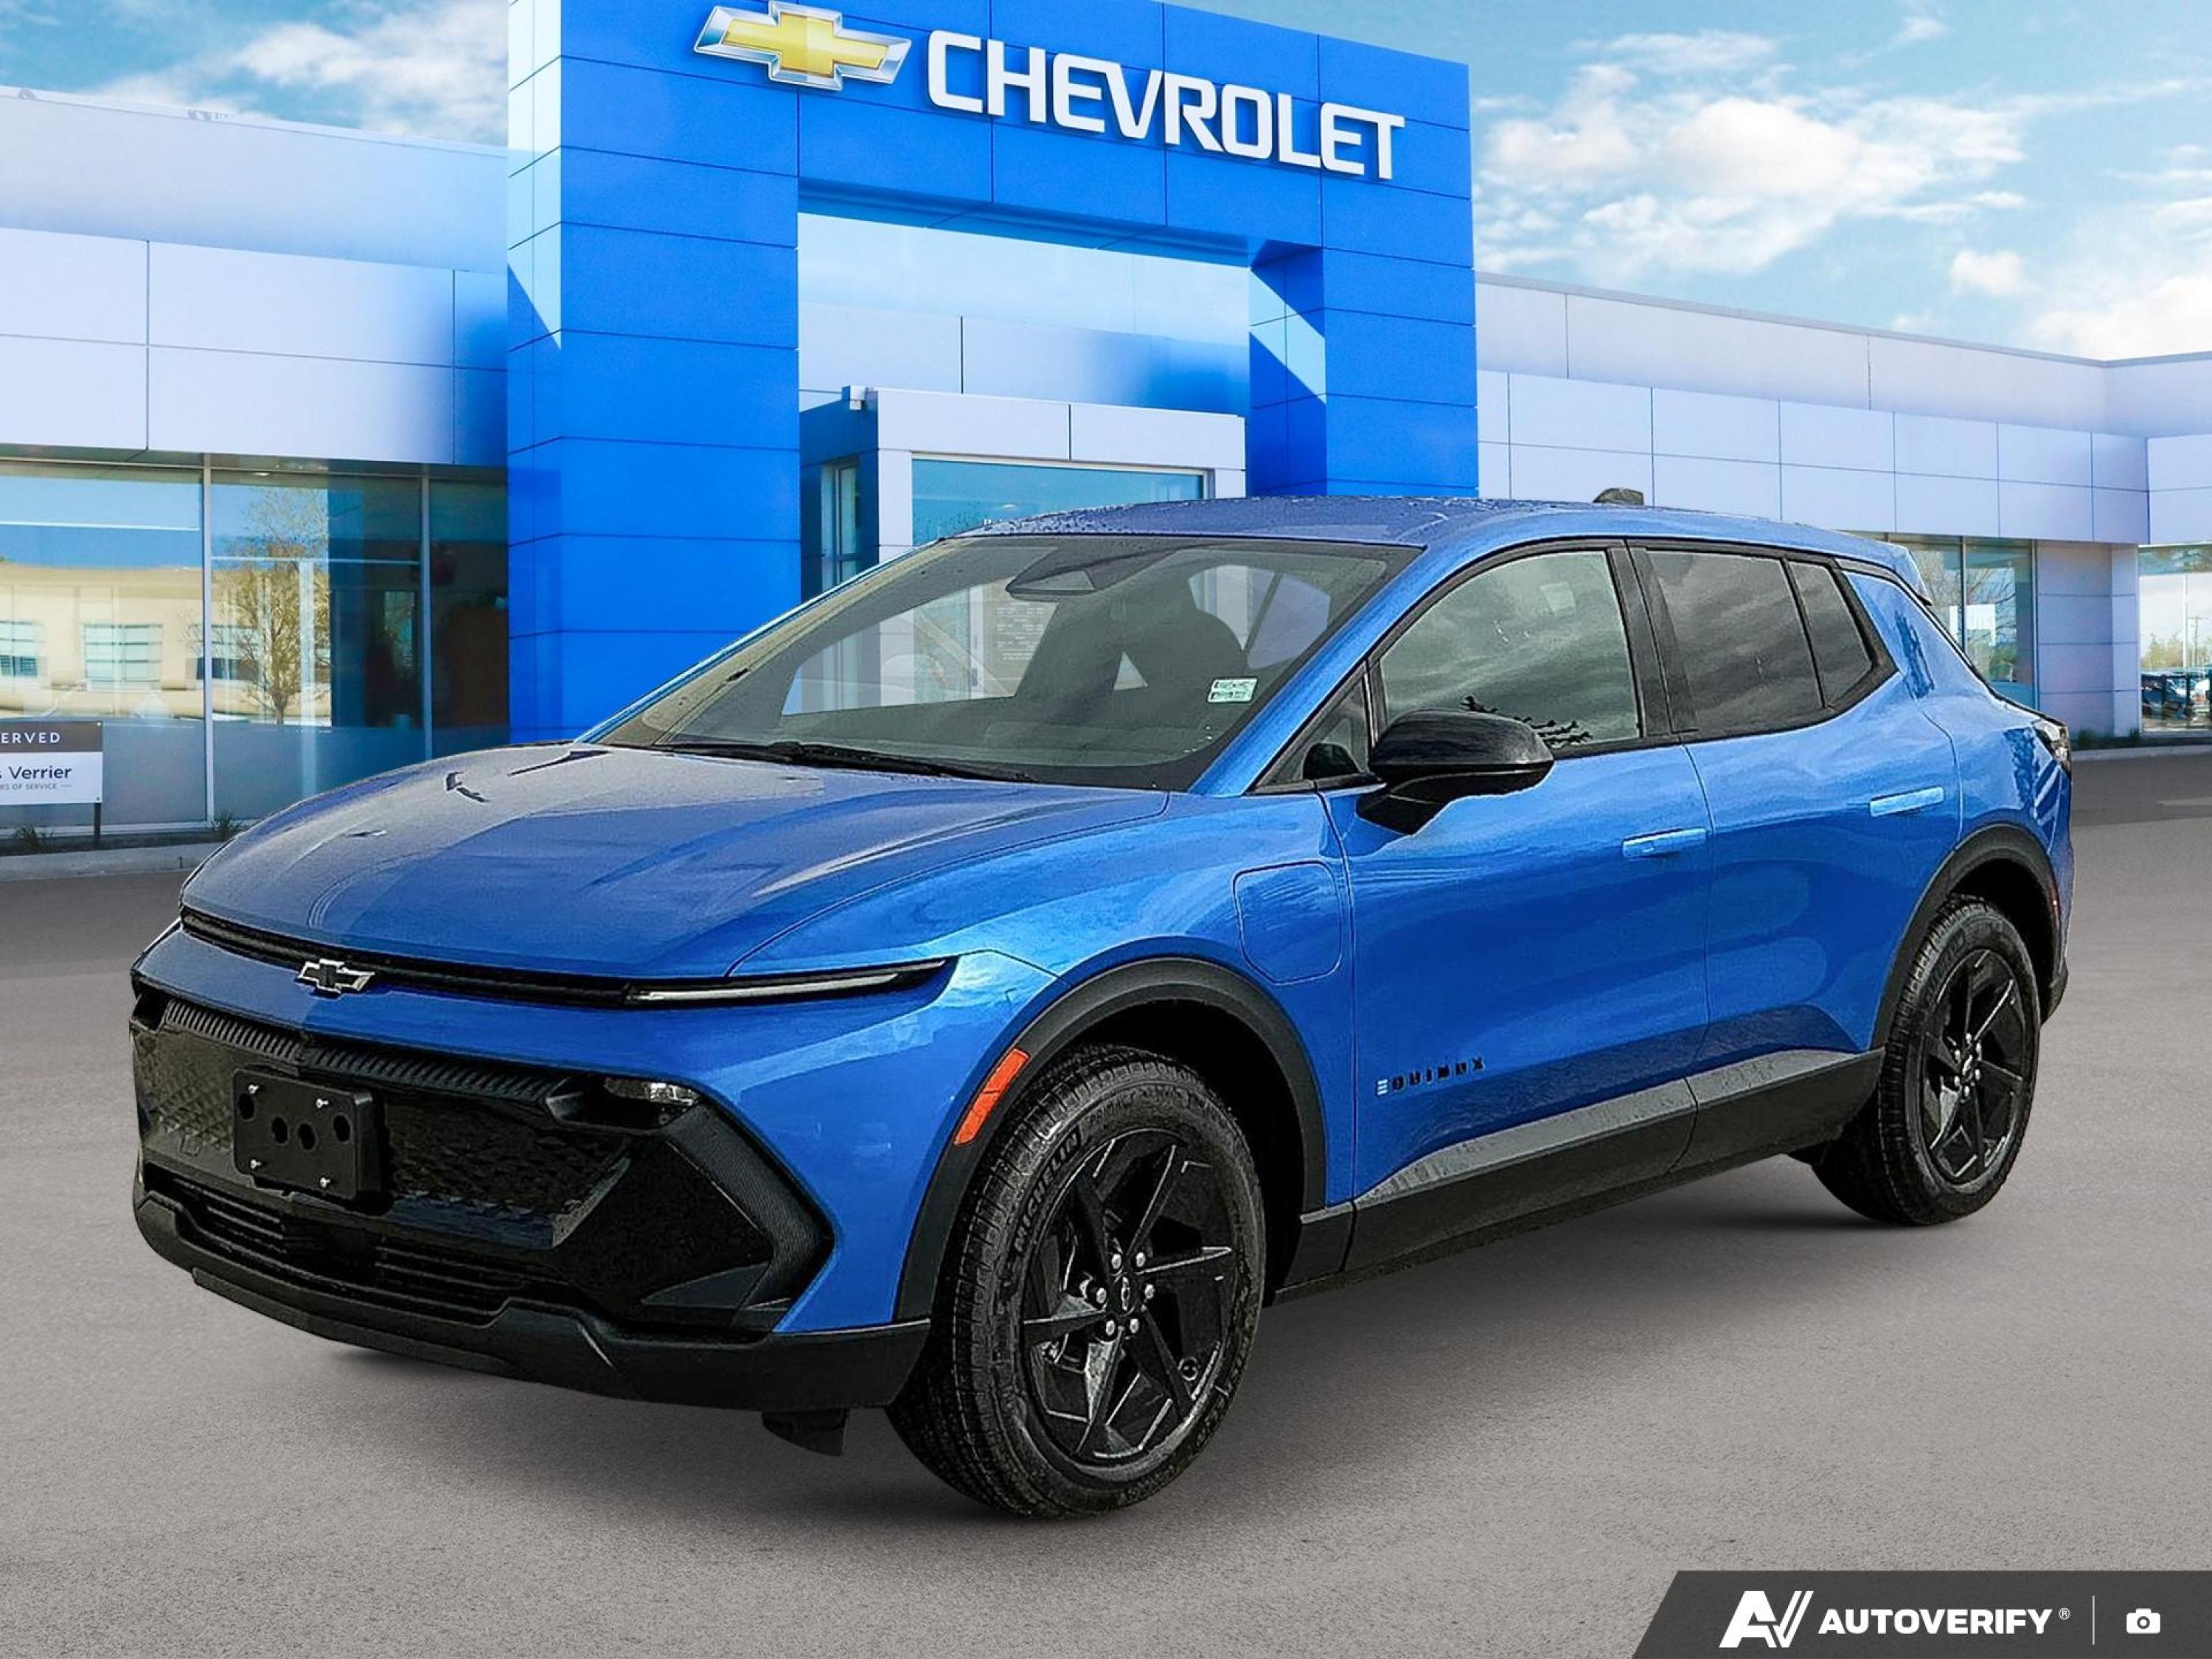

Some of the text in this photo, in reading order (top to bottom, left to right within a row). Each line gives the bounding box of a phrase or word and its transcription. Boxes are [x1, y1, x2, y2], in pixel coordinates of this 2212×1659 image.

[928, 29, 1405, 180] CHEVROLET
[8, 765, 72, 779] Verrier
[1013, 1130, 1079, 1252] MICHELIN
